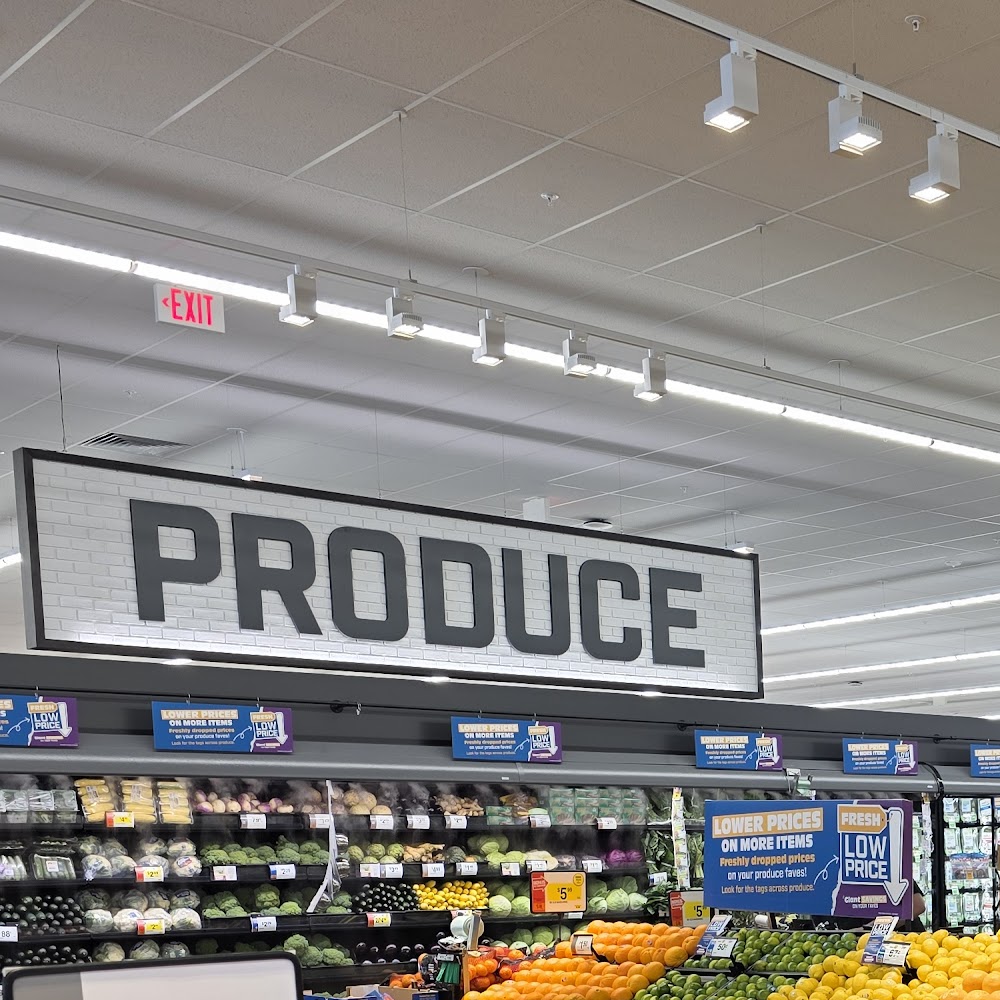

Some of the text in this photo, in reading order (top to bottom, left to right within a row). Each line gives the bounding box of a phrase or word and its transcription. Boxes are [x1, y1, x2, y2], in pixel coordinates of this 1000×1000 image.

[170, 287, 214, 326] EXIT
[130, 498, 706, 669] PRODUCE
[34, 712, 59, 723] LOW
[163, 710, 238, 719] LOWER PRICES
[35, 721, 60, 730] PRICE
[255, 721, 277, 731] LOW
[714, 811, 821, 835] LOWER PRICES
[841, 813, 881, 826] FRESH
[721, 834, 813, 853] ON MORE ITEMS
[844, 835, 887, 860] LOW
[720, 853, 815, 867] Freshly dropped prices
[728, 867, 807, 881] on your produce faves!
[845, 859, 888, 880] PRICE
[721, 884, 814, 895] Look for the tags across produce.
